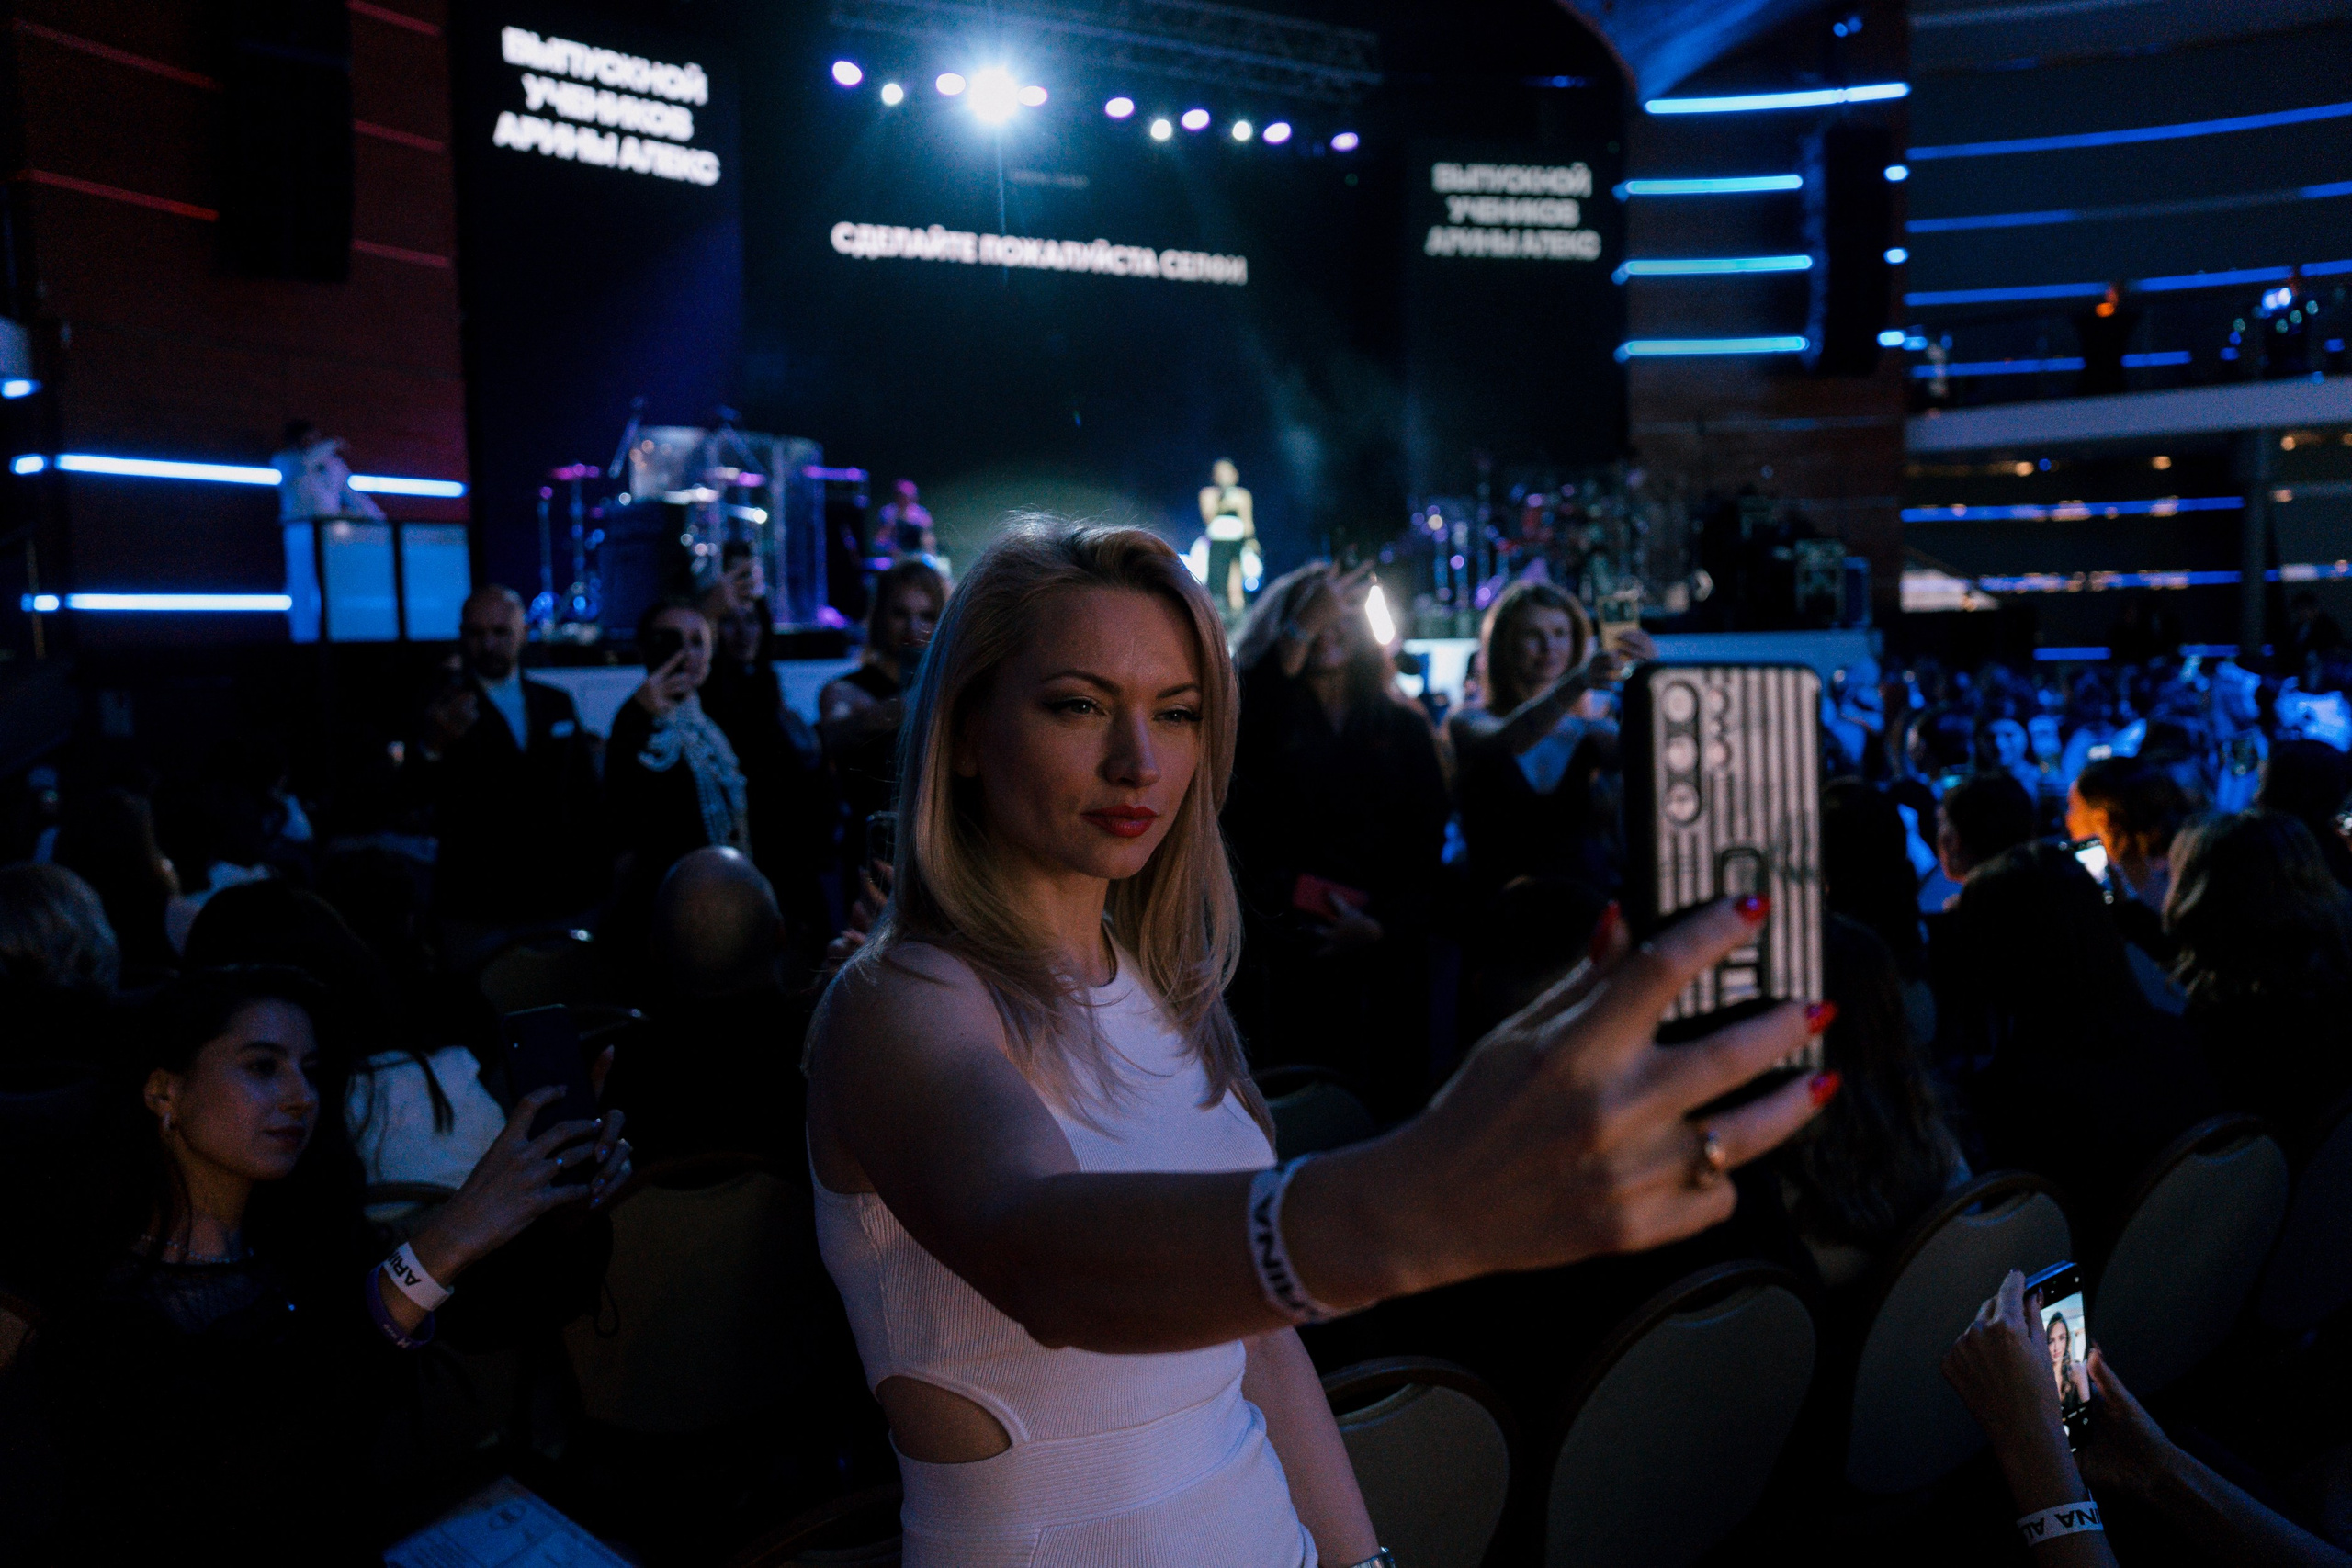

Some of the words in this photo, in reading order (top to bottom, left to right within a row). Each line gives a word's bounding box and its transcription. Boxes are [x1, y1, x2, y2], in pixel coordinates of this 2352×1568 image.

[502, 26, 708, 107] ВЫПУСКНОЙ
[521, 73, 694, 142] УЧЕНИКОВ
[493, 110, 619, 168] АРИНЫ
[616, 135, 720, 186] АЛЕКС
[1432, 162, 1592, 198] ВЫПУСКНОЙ
[1446, 194, 1580, 229] УЧЕНИКОВ
[831, 221, 978, 265] СДЕЛАЙТЕ
[979, 233, 1159, 278] ПОЖАЛУЙСТА
[1158, 249, 1249, 286] СЕЛФИ
